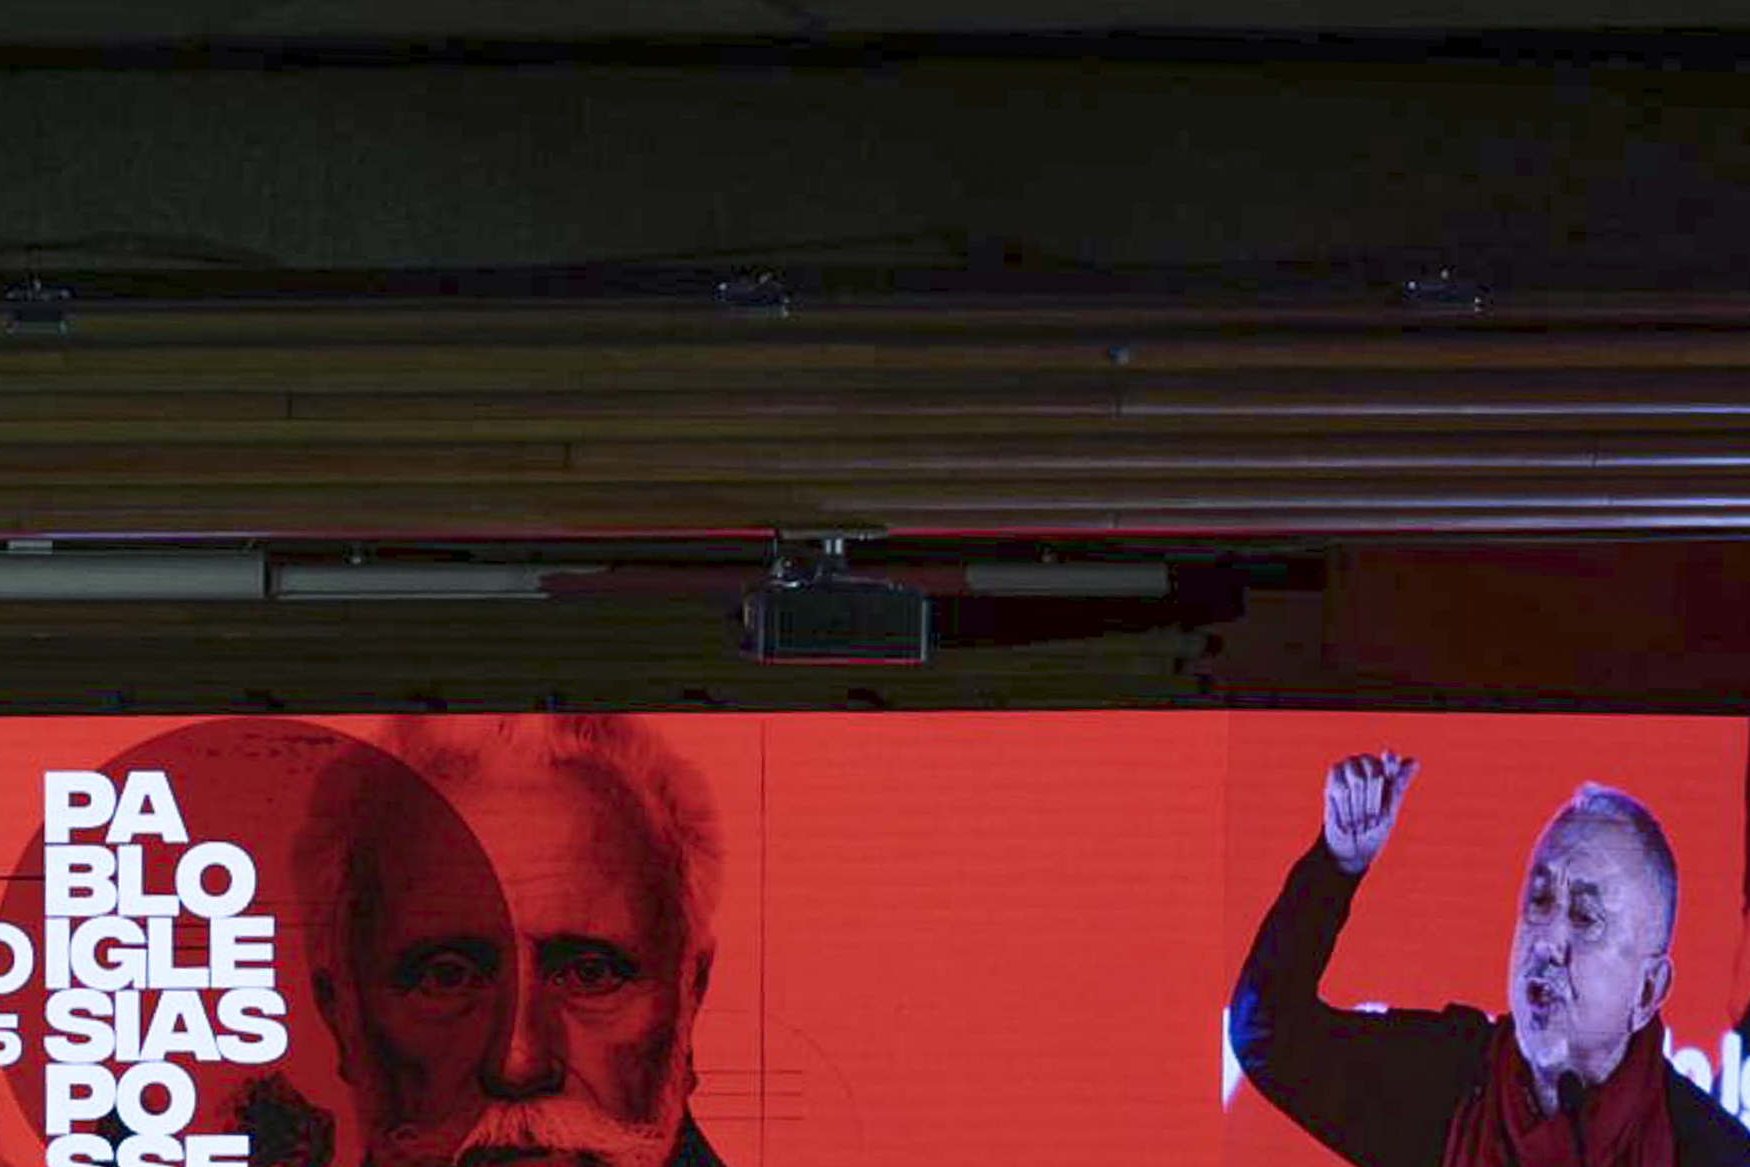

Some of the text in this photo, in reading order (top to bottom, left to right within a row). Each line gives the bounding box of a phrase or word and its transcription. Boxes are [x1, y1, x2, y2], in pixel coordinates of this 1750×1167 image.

[44, 769, 189, 843] PA
[45, 842, 257, 917] BLO
[45, 916, 275, 989] IGLE
[44, 988, 288, 1063] SIAS
[45, 1061, 197, 1136] PO
